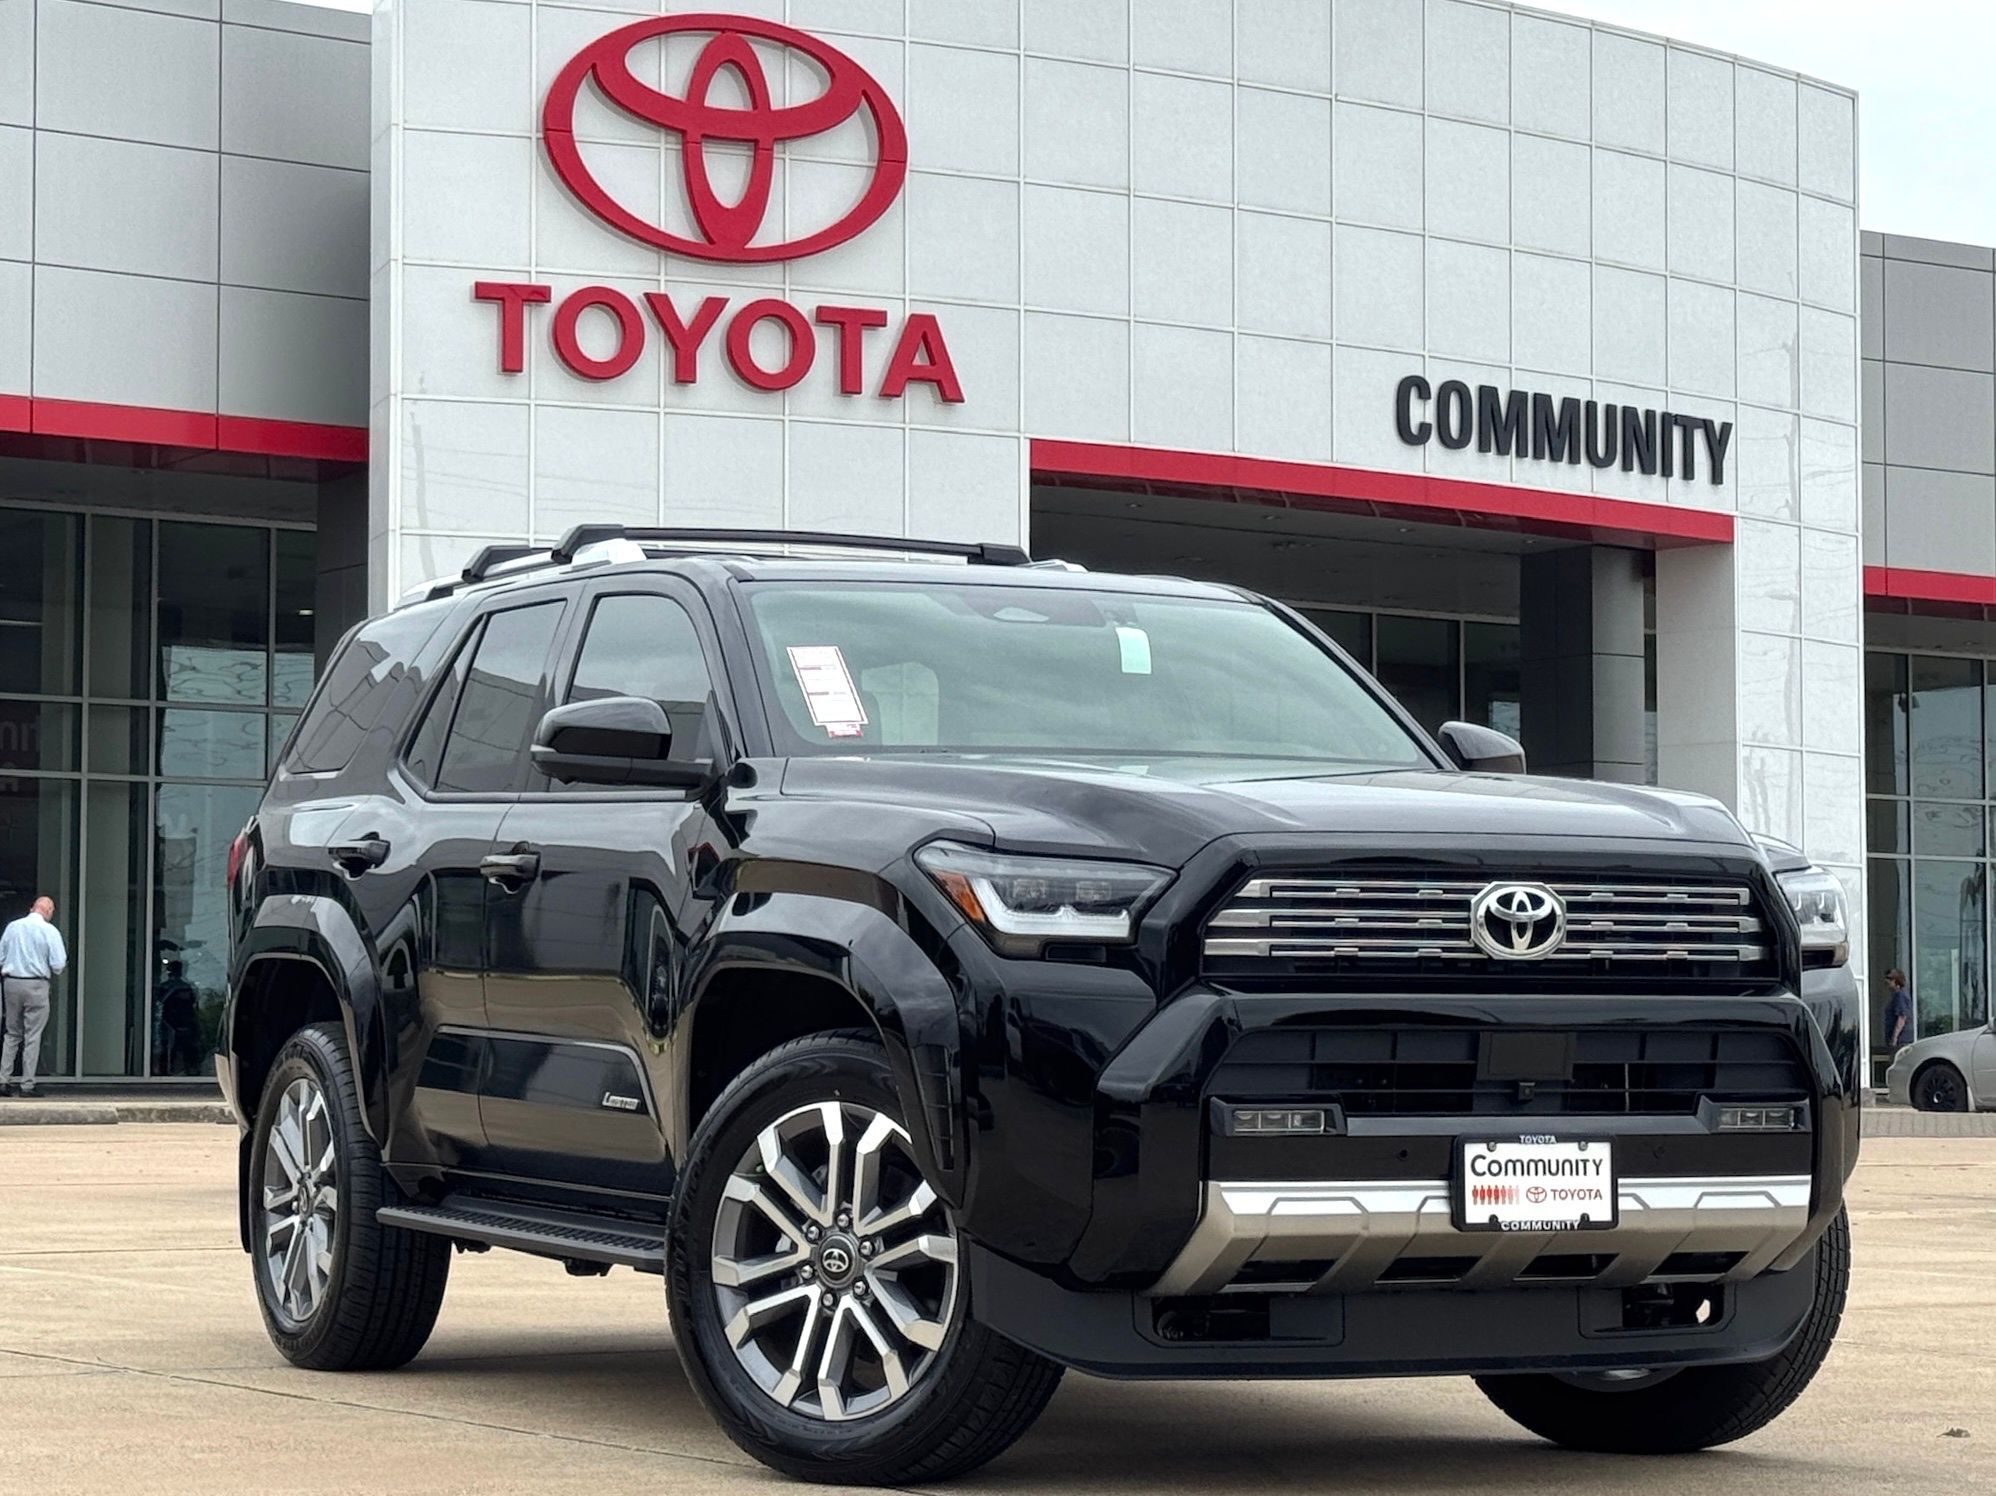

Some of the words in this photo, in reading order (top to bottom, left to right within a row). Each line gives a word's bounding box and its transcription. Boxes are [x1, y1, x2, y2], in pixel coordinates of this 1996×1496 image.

[474, 281, 966, 403] TOYOTA
[1396, 375, 1733, 485] COMMUNITY
[1519, 1134, 1557, 1145] TOYOTA
[1551, 1188, 1603, 1201] TOYOTA
[1500, 1220, 1581, 1231] COMMUNITY
